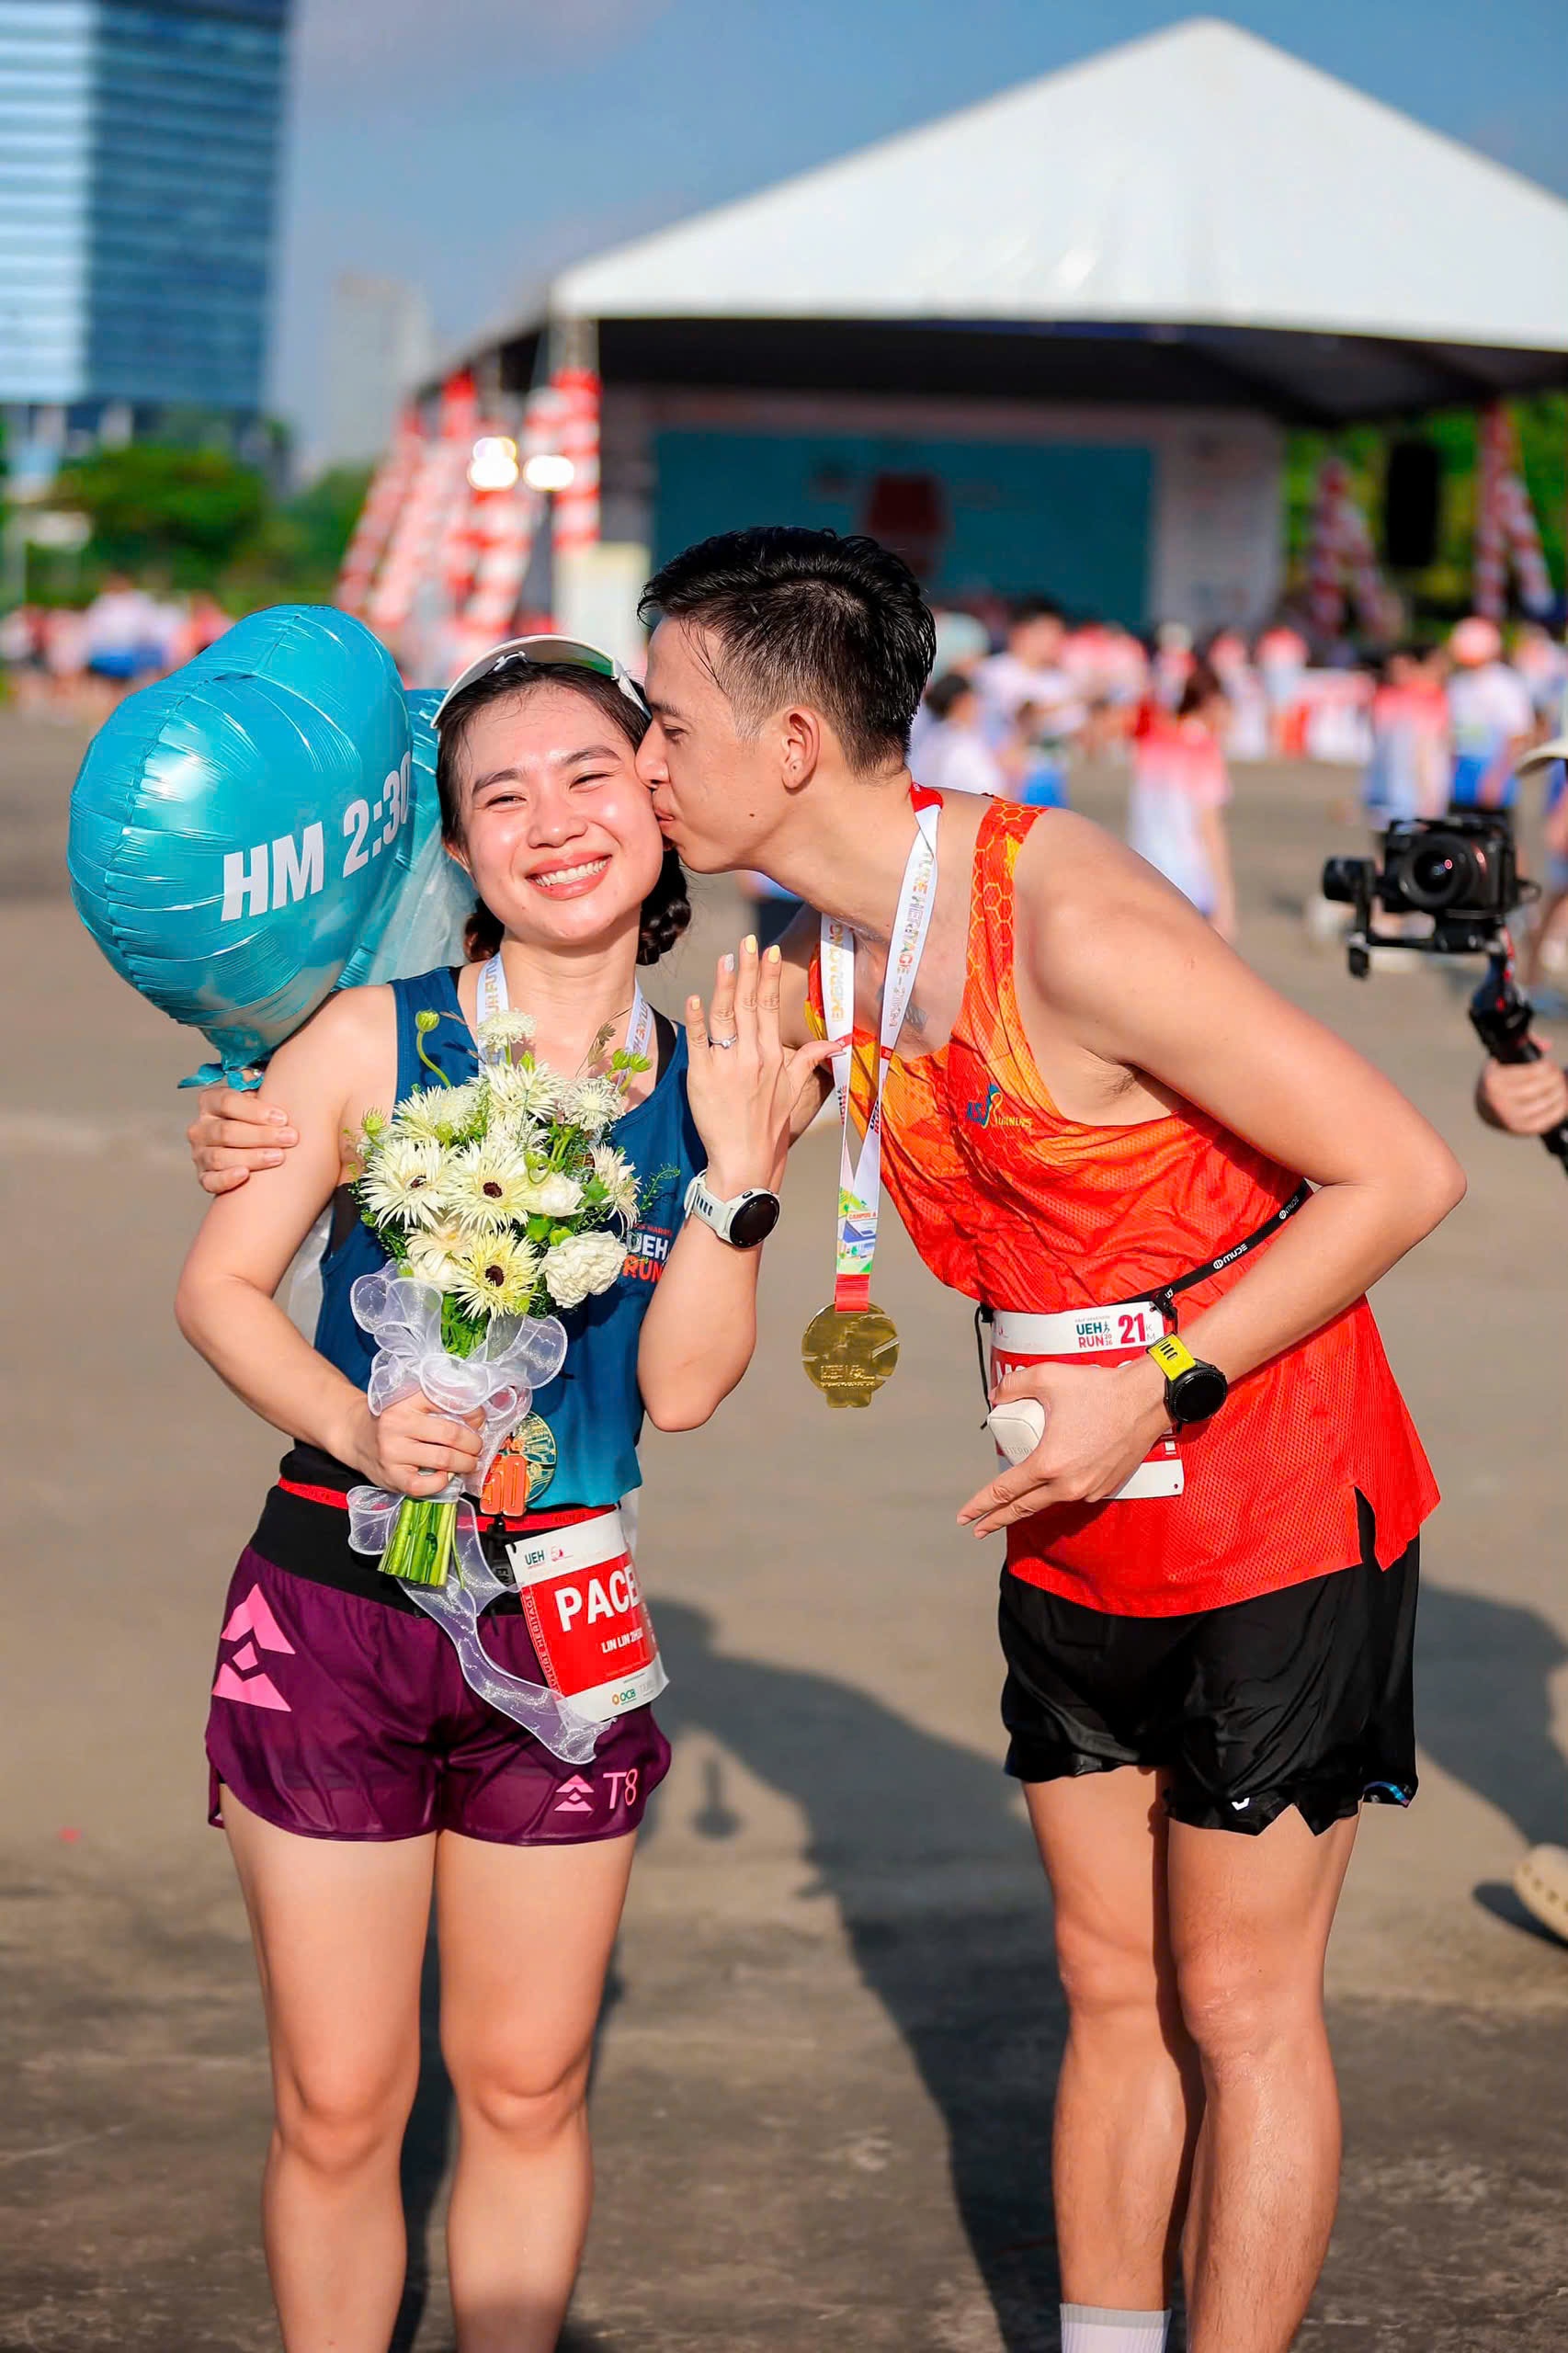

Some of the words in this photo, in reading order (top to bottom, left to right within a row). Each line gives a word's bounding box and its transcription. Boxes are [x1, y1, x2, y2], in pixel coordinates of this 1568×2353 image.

[221, 821, 324, 922] HM
[342, 751, 414, 880] 2:30
[626, 1231, 668, 1261] UEH
[622, 1255, 664, 1283] RUN
[1076, 1322, 1102, 1336] UEH
[1118, 1313, 1146, 1345] 21
[1145, 1324, 1153, 1332] K
[1146, 1333, 1156, 1341] M
[1078, 1334, 1105, 1348] RUN
[524, 1550, 545, 1565] UEH
[554, 1563, 641, 1632] PACE
[525, 1595, 545, 1648] HERITAGE
[601, 1639, 618, 1654] LIN
[617, 1633, 631, 1648] LIN
[619, 1688, 636, 1702] OCB
[603, 1768, 639, 1810] T8
